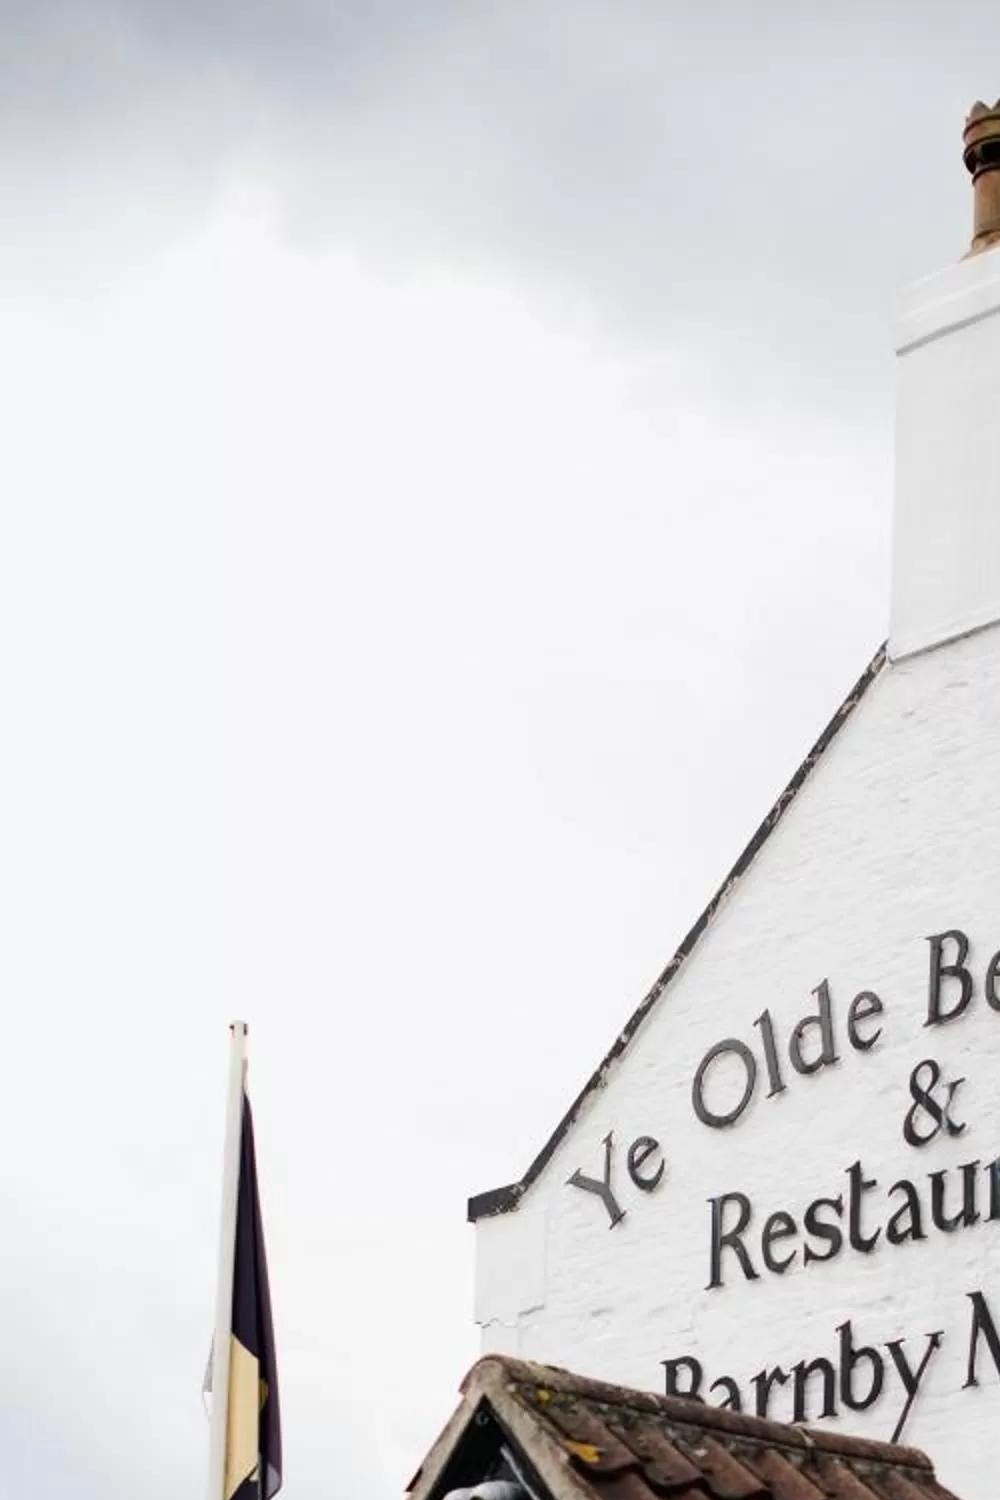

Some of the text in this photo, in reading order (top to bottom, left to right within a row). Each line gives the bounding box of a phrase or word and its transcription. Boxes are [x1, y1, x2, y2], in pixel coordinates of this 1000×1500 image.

[568, 1131, 665, 1230] Ye
[692, 979, 884, 1130] Olde
[903, 1059, 967, 1148] &
